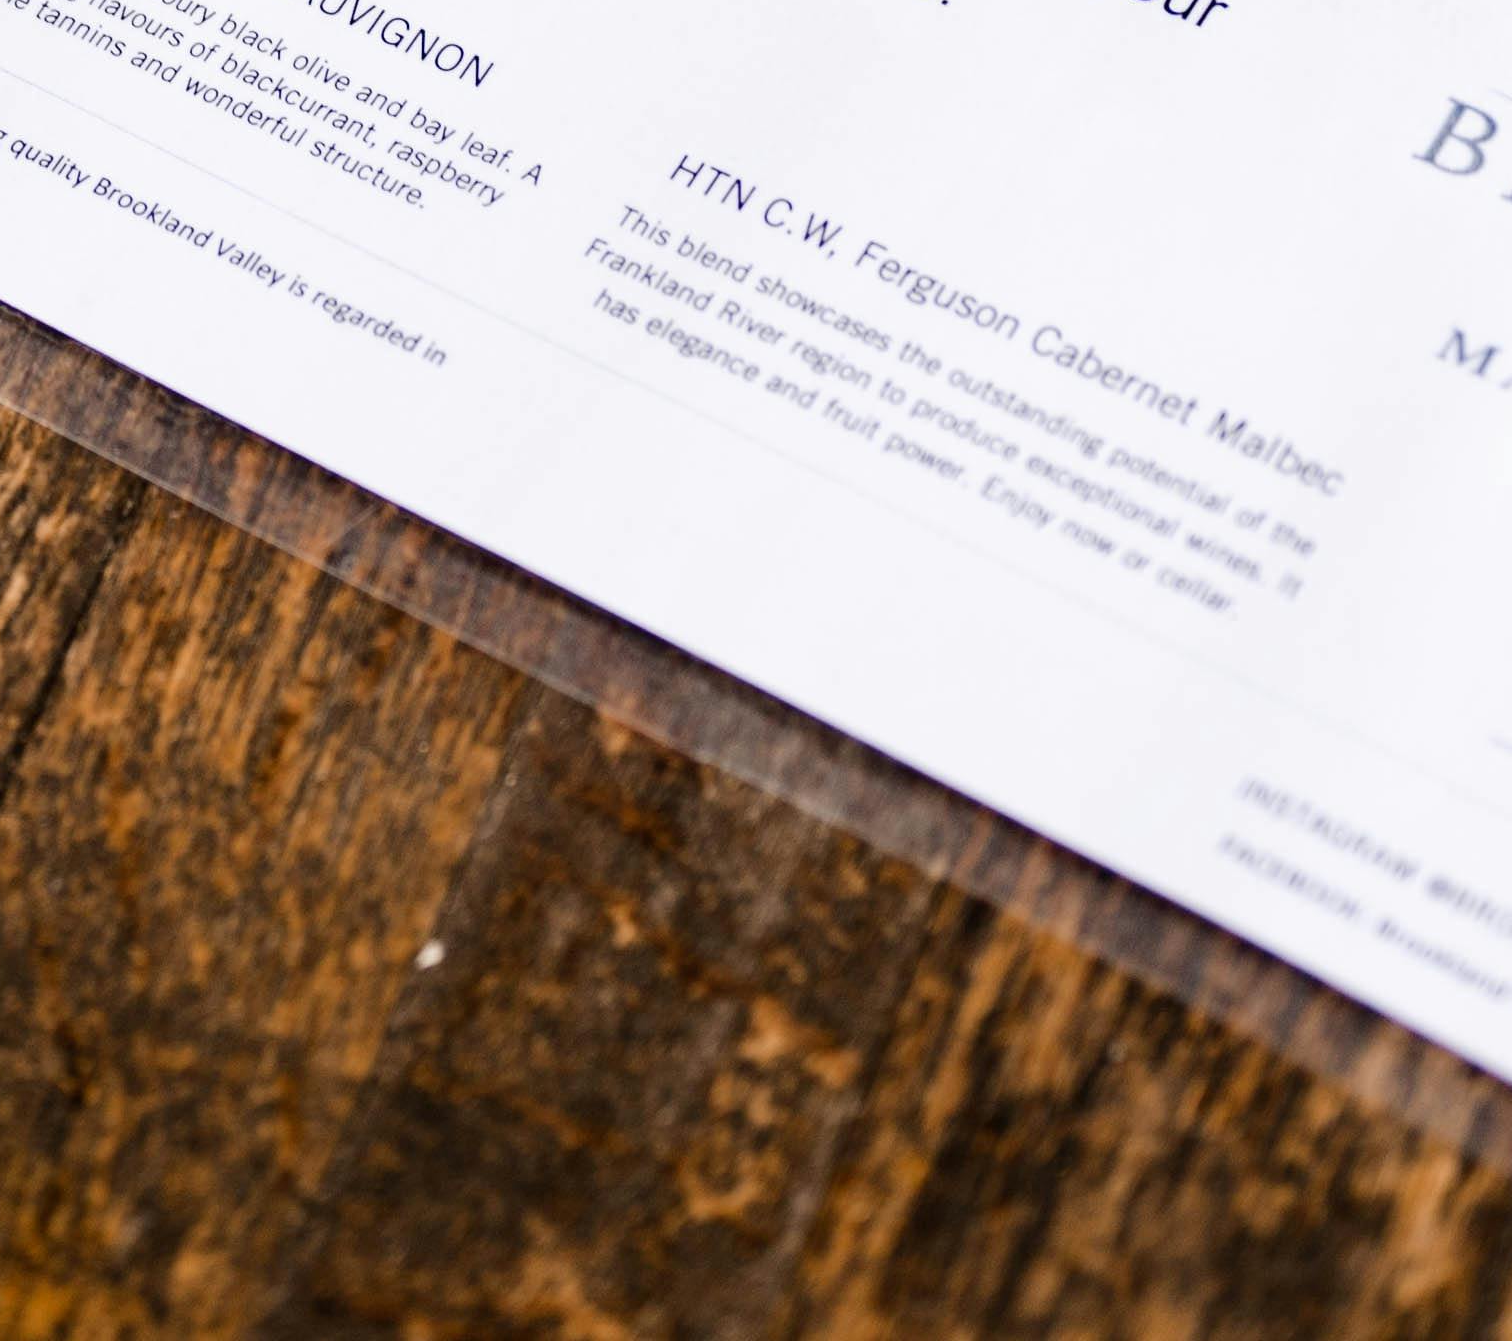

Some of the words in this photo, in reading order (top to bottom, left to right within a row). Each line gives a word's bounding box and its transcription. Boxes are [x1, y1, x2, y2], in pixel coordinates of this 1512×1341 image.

[36, 0, 127, 57] tannins
[130, 51, 183, 83] and
[185, 77, 308, 147] wonderful
[309, 140, 424, 209] structure.
[189, 42, 221, 62] of
[220, 52, 376, 149] blackcurrant,
[387, 140, 505, 207] raspberry
[220, 13, 287, 61] black
[292, 55, 351, 92] olive
[355, 86, 408, 118] and
[409, 107, 456, 145] bay
[460, 132, 514, 173] leaf.
[521, 164, 542, 186] A
[10, 139, 91, 189] quality
[92, 177, 214, 248] Brookland
[217, 238, 286, 288] Valley
[287, 279, 309, 298] is
[311, 291, 423, 353] regarded
[422, 342, 447, 366] in
[670, 154, 756, 211] HTN
[855, 240, 1021, 340] Ferguson
[1031, 325, 1198, 426] Cabernet
[1207, 408, 1345, 497] Malbec
[584, 237, 715, 312] Frankland
[718, 300, 787, 345] River
[791, 340, 873, 390] region
[879, 378, 907, 406] to
[908, 398, 1020, 461] produce
[1024, 455, 1181, 537] exceptional
[593, 288, 641, 325] has
[645, 317, 761, 383] elegance
[764, 374, 820, 410] and
[822, 398, 881, 441] fruit
[980, 474, 1056, 529] Enjoy
[1060, 520, 1117, 556] now
[1121, 550, 1151, 571] or
[619, 205, 671, 246] This
[676, 234, 753, 284] blend
[754, 276, 892, 353] showcases
[898, 340, 943, 376] the
[947, 368, 1105, 460] outstanding
[1105, 447, 1232, 514] potential
[1234, 509, 1268, 531] of
[1269, 521, 1317, 559] the
